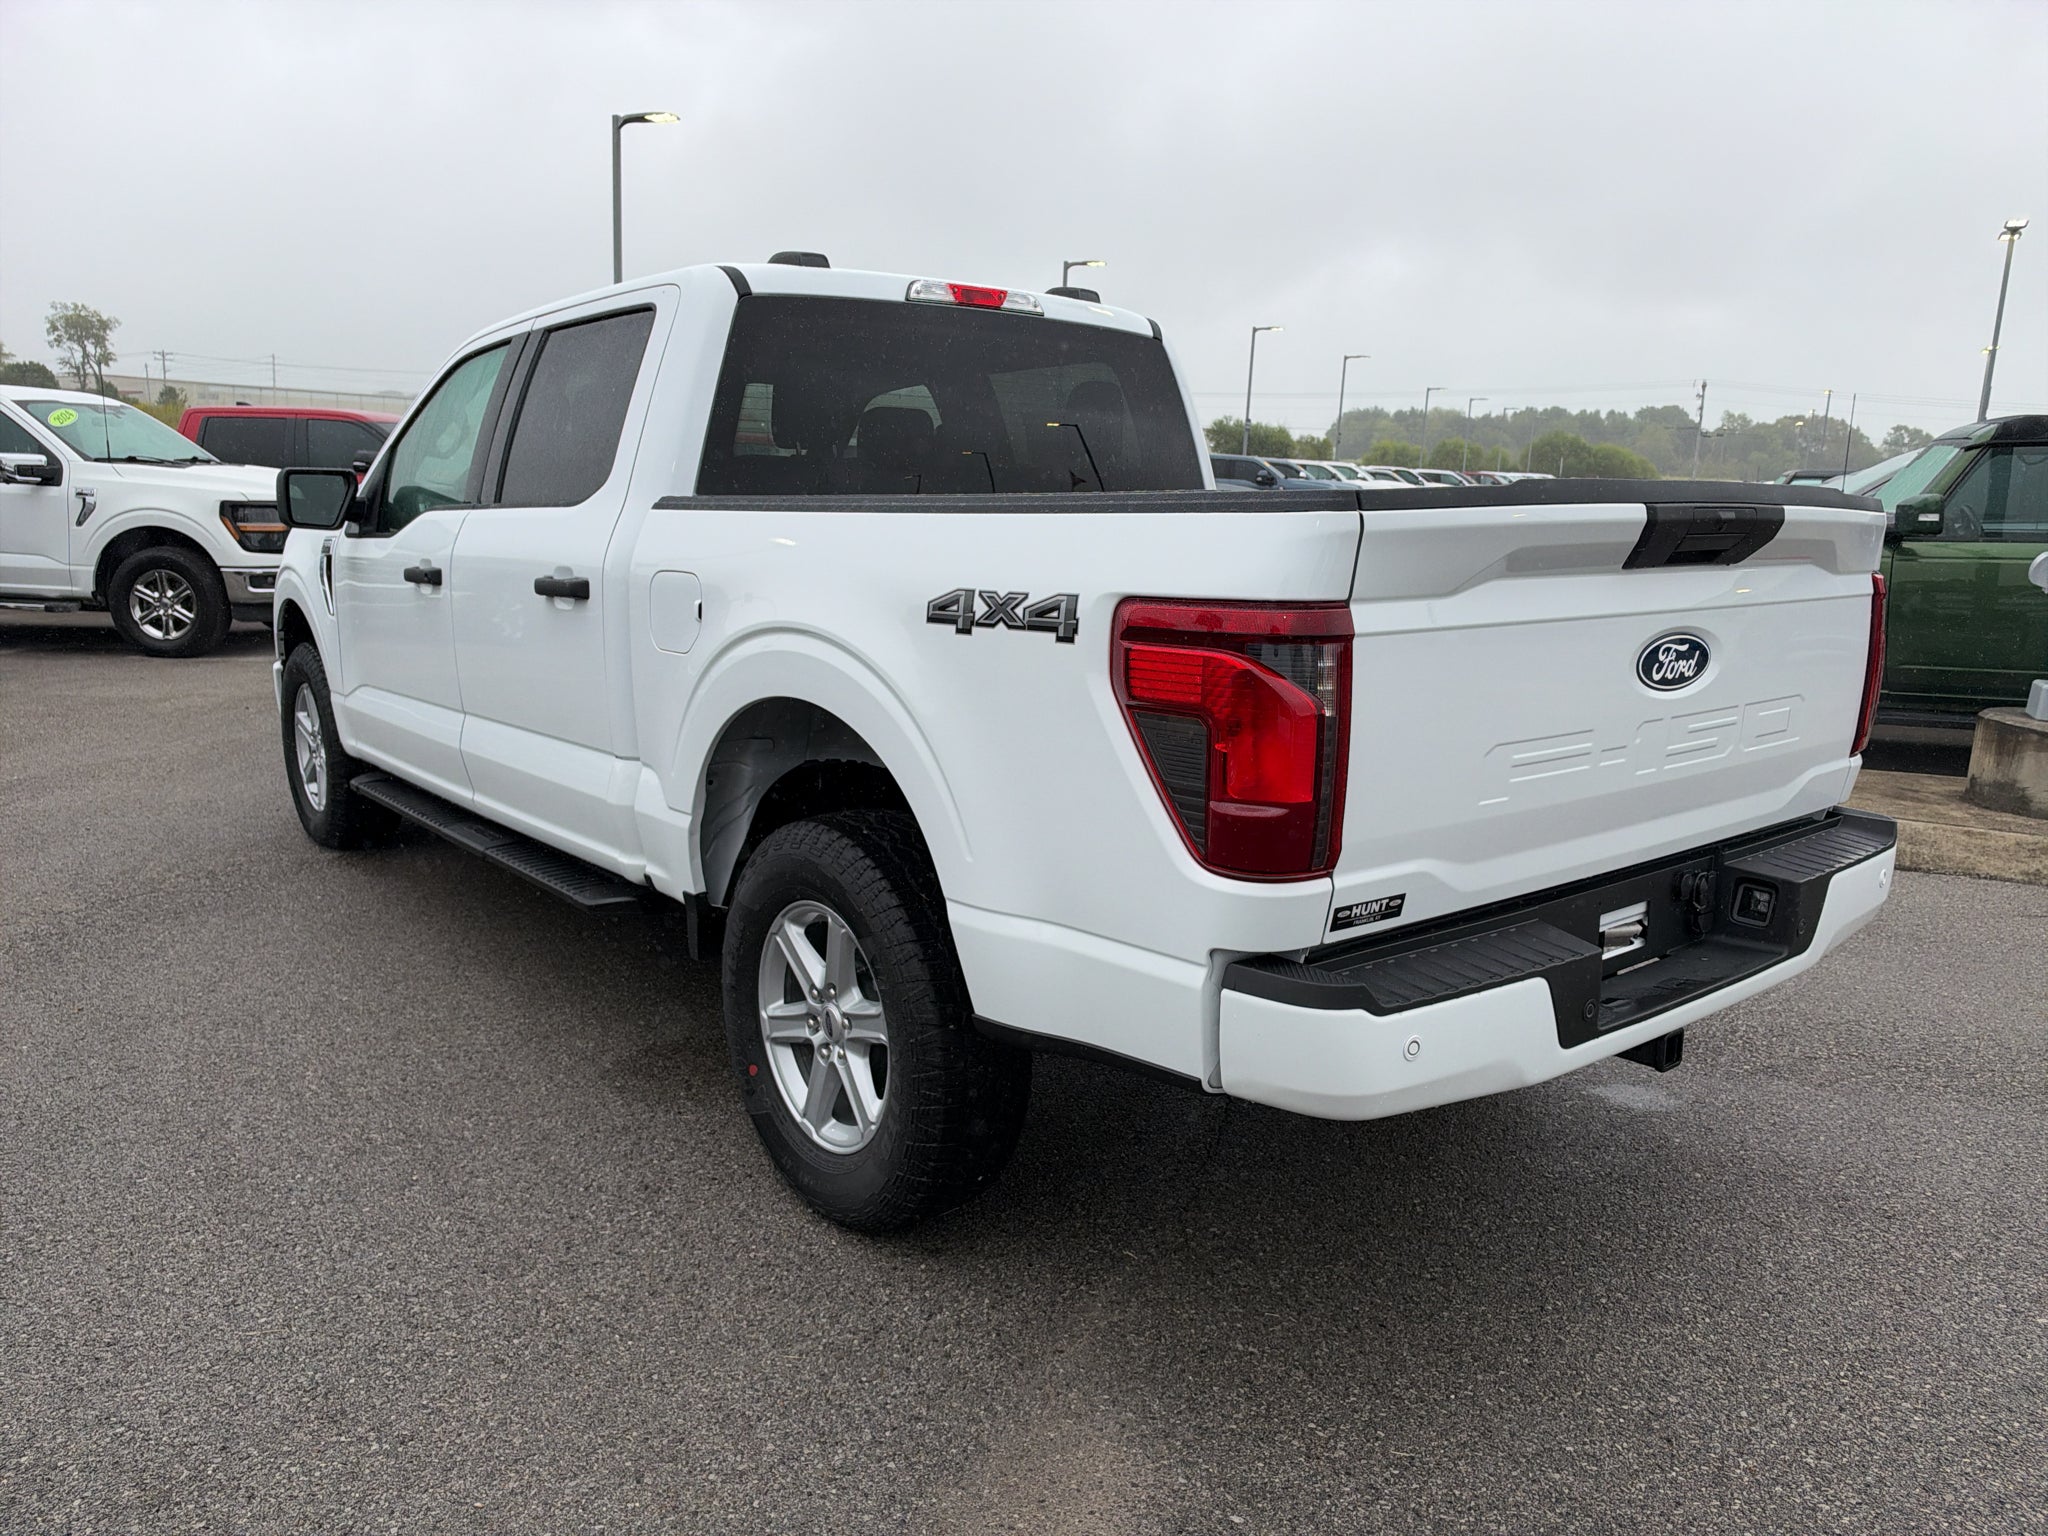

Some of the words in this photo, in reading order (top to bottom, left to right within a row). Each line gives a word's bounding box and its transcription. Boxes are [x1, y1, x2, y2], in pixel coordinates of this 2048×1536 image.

[1652, 643, 1700, 681] Ford
[1477, 694, 1805, 806] F-150
[1350, 899, 1390, 918] HUNT
